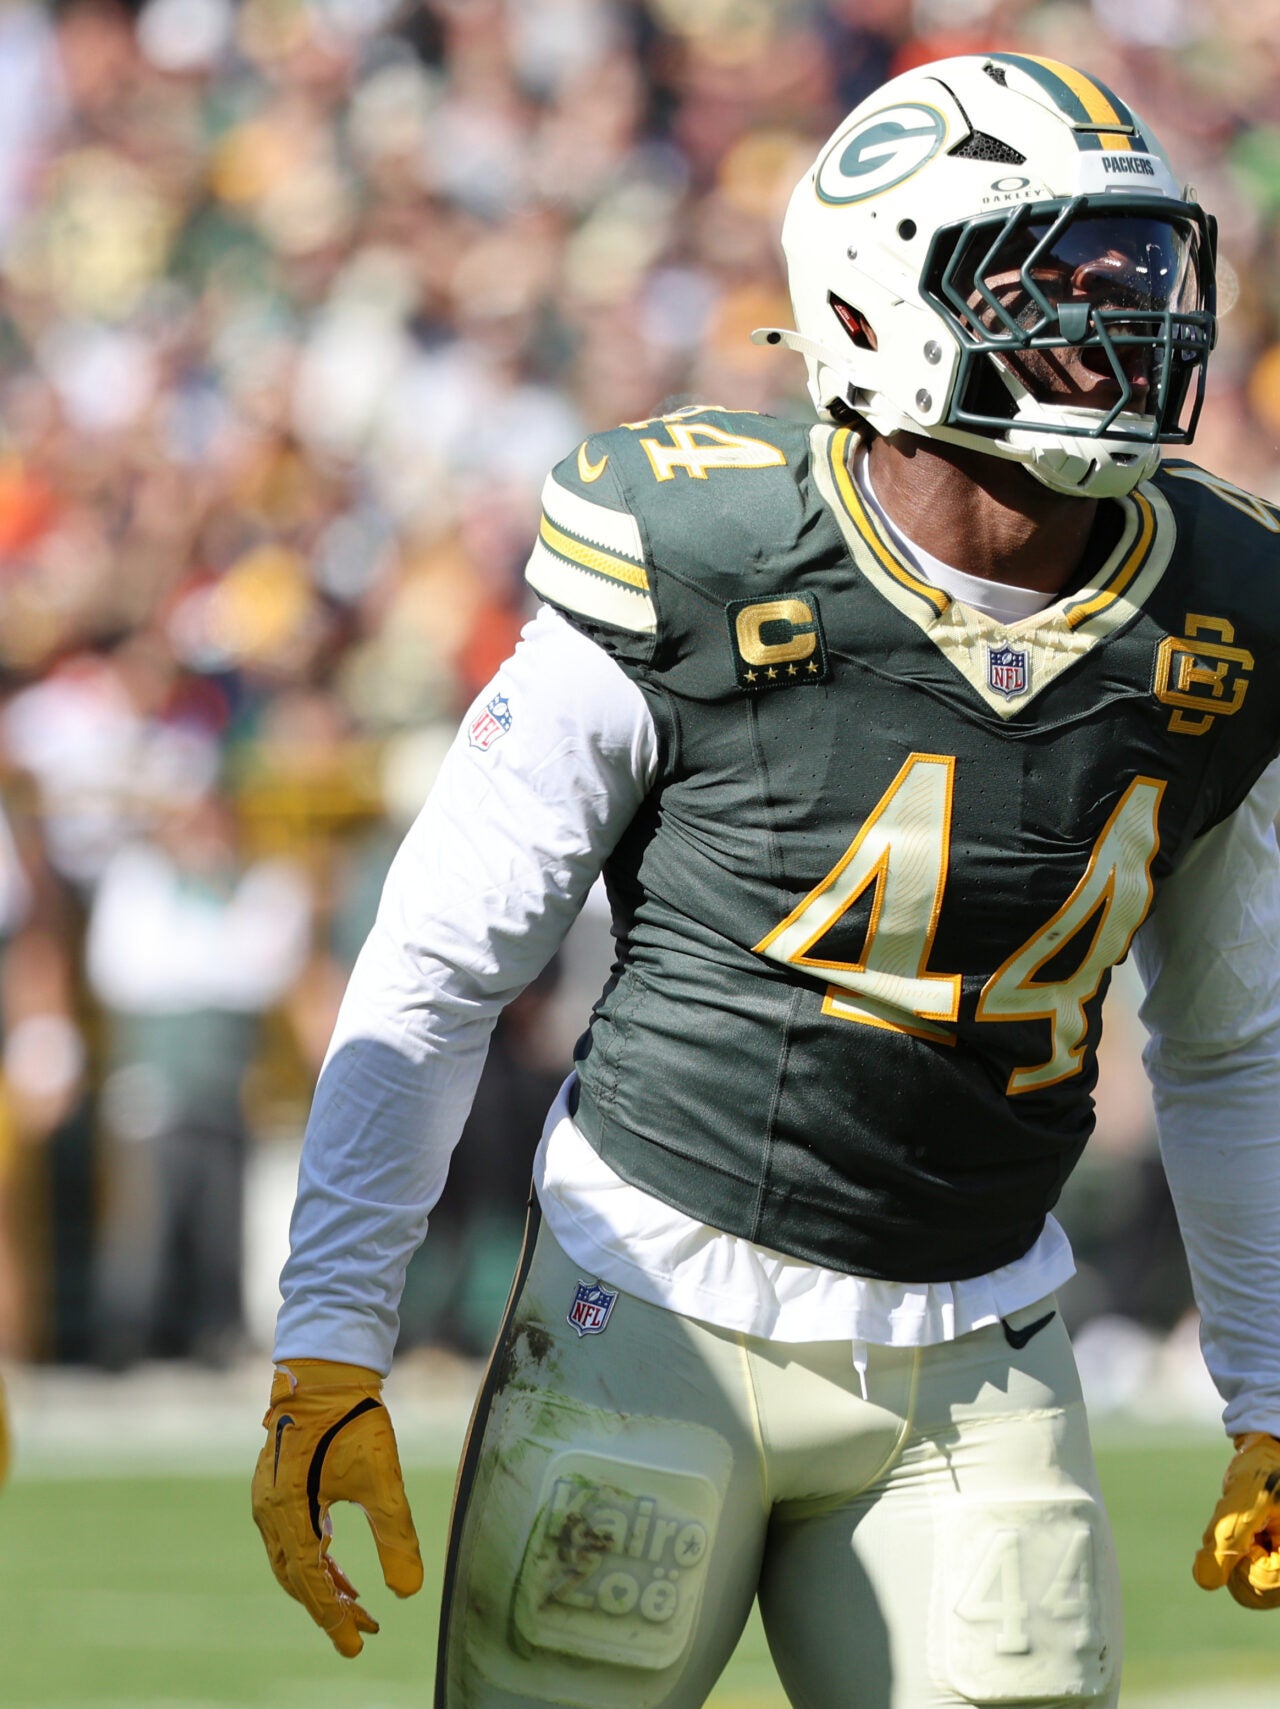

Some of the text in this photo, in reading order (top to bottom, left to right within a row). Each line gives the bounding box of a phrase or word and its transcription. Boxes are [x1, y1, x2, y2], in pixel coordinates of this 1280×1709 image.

[1102, 157, 1156, 176] PACKERS
[982, 189, 1042, 205] OAKLEY
[736, 599, 817, 666] C
[993, 666, 1023, 690] NFL
[472, 711, 500, 747] NFL
[751, 752, 1167, 1096] 44
[572, 1301, 601, 1327] NFL
[953, 1528, 1097, 1656] 44
